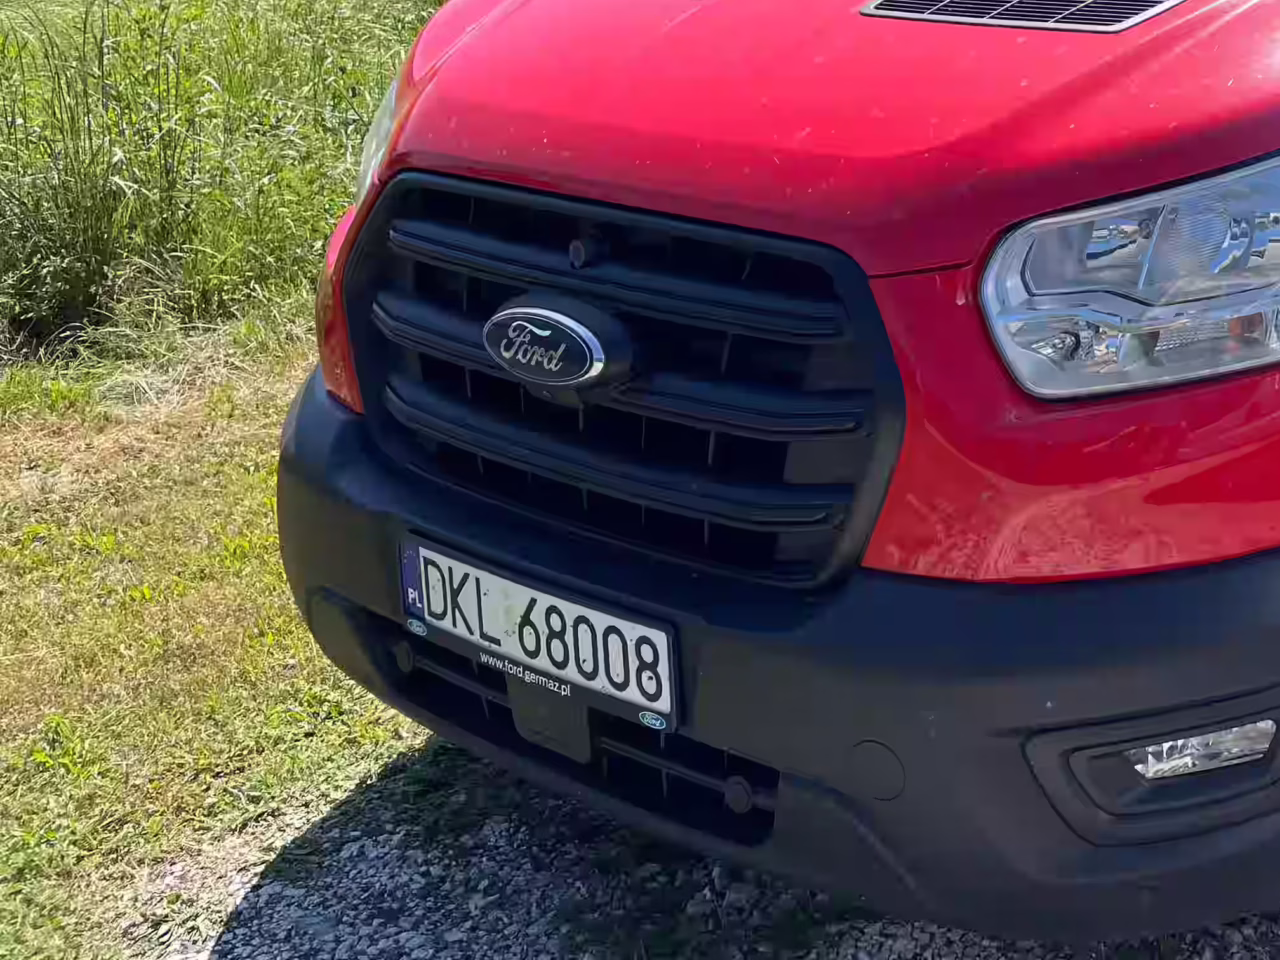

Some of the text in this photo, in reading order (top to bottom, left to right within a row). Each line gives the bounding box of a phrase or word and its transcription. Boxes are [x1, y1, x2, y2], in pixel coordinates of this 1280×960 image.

[500, 321, 566, 371] Ford
[408, 587, 422, 608] PL
[423, 556, 662, 703] DKL 68008
[480, 652, 571, 696] www.ford.germaz.pl
